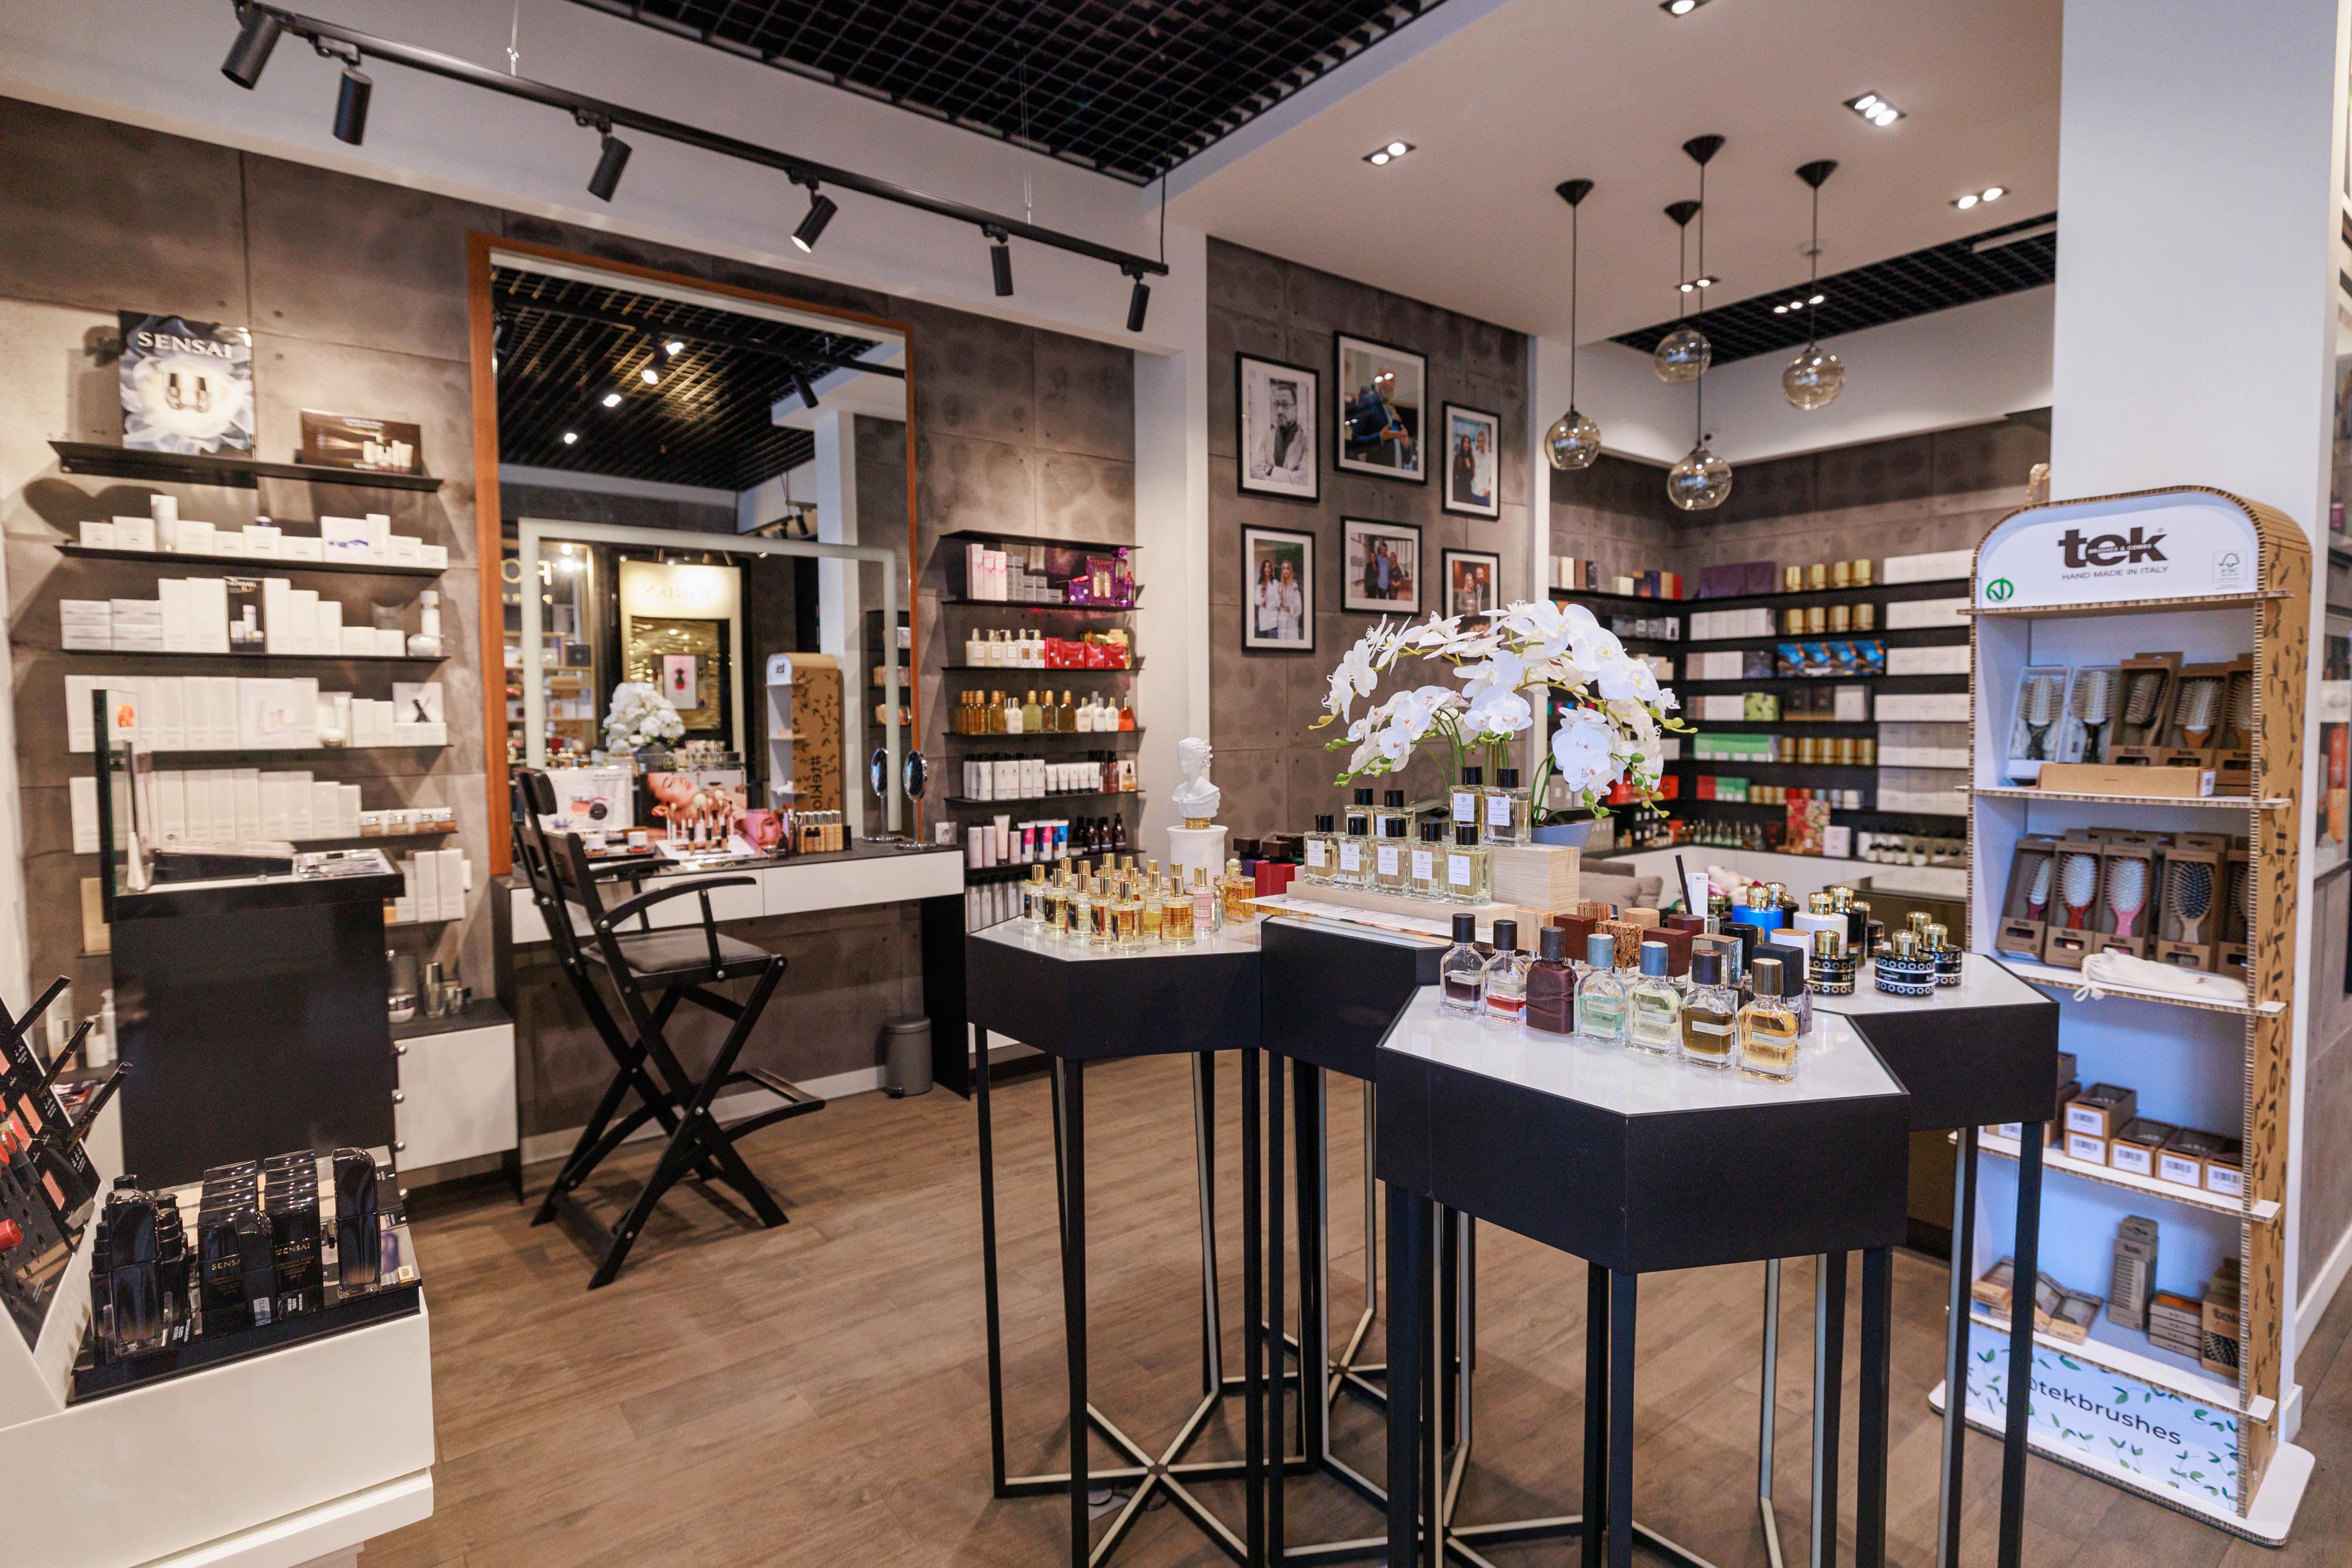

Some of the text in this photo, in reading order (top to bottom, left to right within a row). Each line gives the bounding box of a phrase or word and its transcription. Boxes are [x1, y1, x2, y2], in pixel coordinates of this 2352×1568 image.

[138, 330, 233, 359] SENSAI
[2058, 527, 2169, 569] tek
[2062, 566, 2169, 580] HAND MADE IN ITALY
[275, 1242, 310, 1256] SENSAI
